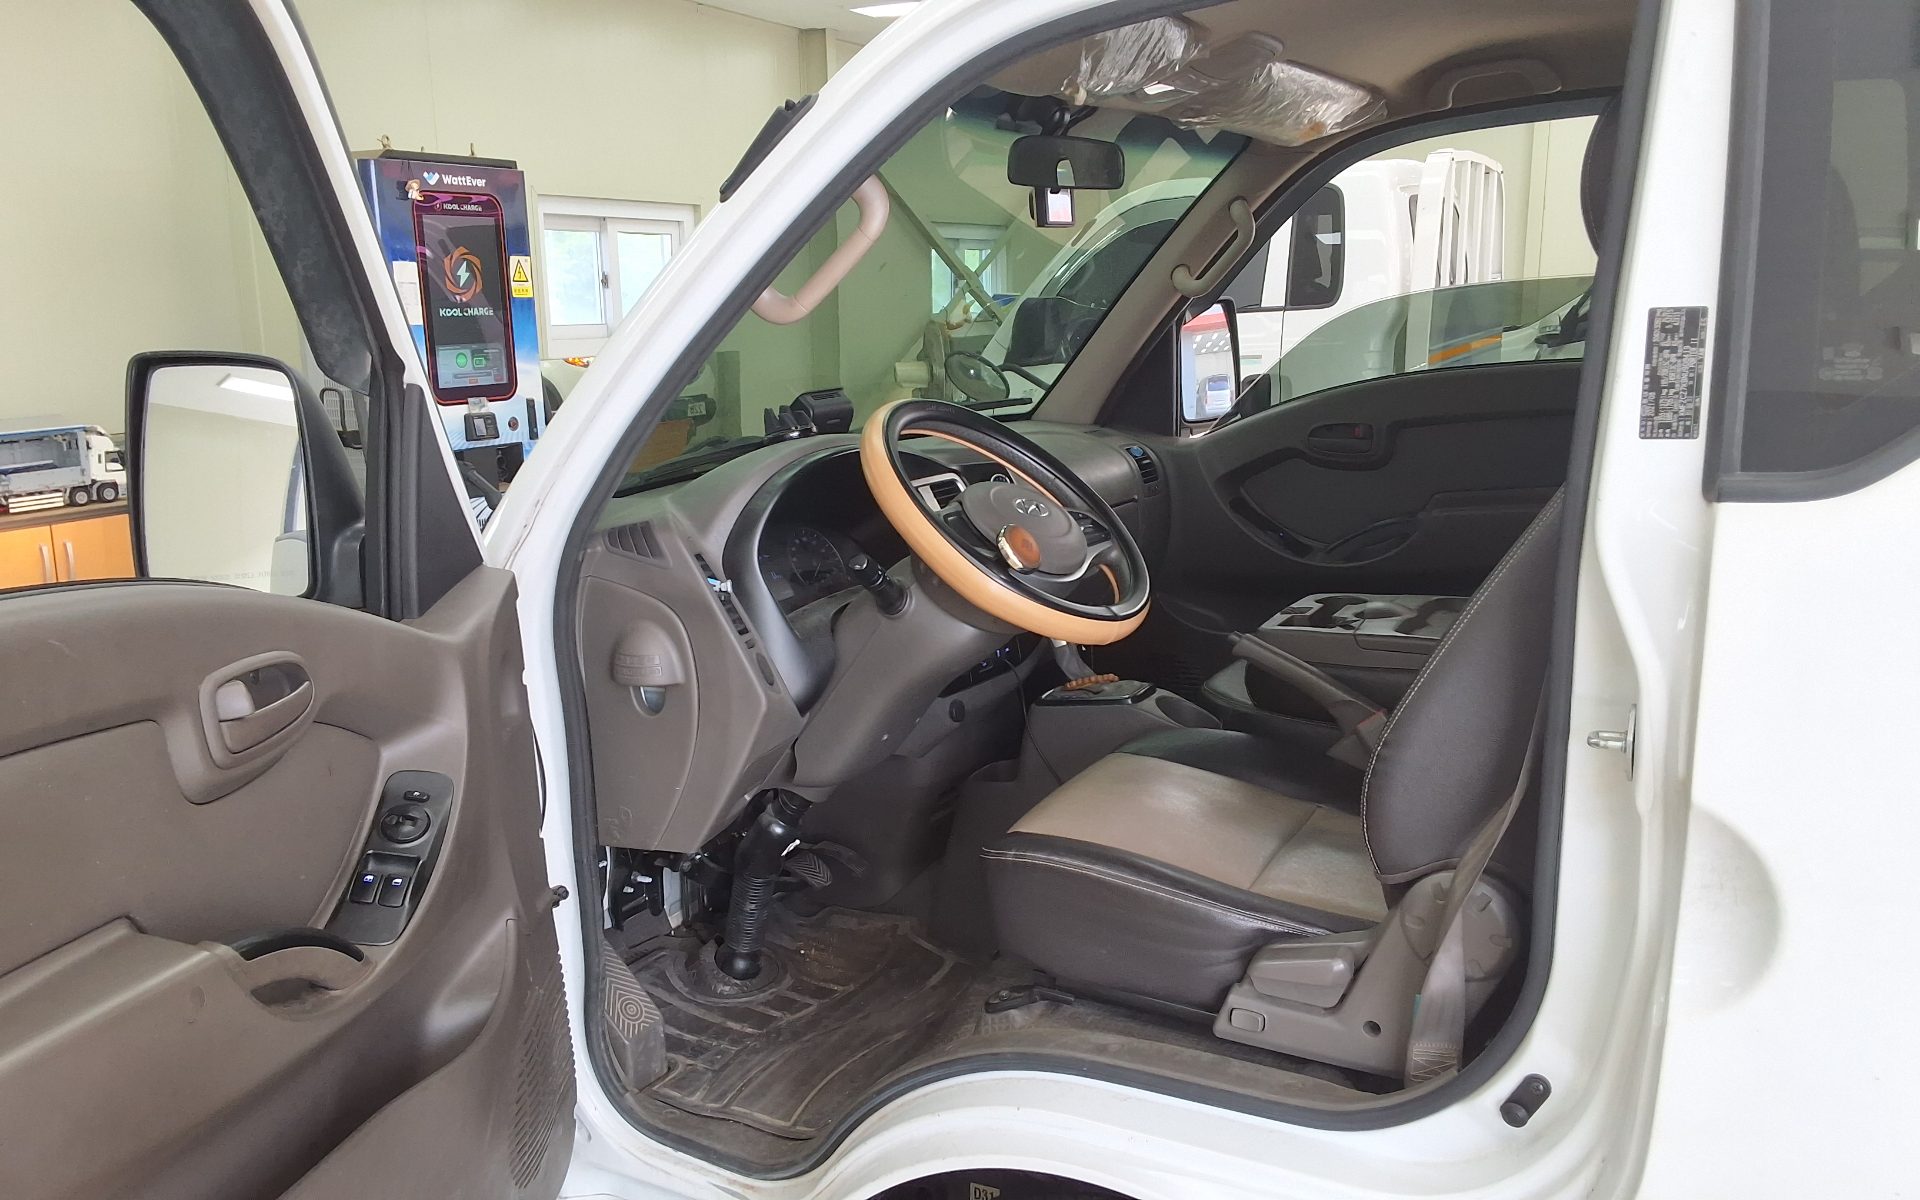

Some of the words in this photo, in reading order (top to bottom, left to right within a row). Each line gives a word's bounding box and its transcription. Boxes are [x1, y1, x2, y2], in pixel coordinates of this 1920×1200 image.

[441, 174, 487, 187] WattEver
[439, 307, 463, 317] KOOL
[463, 307, 494, 316] CHARGE
